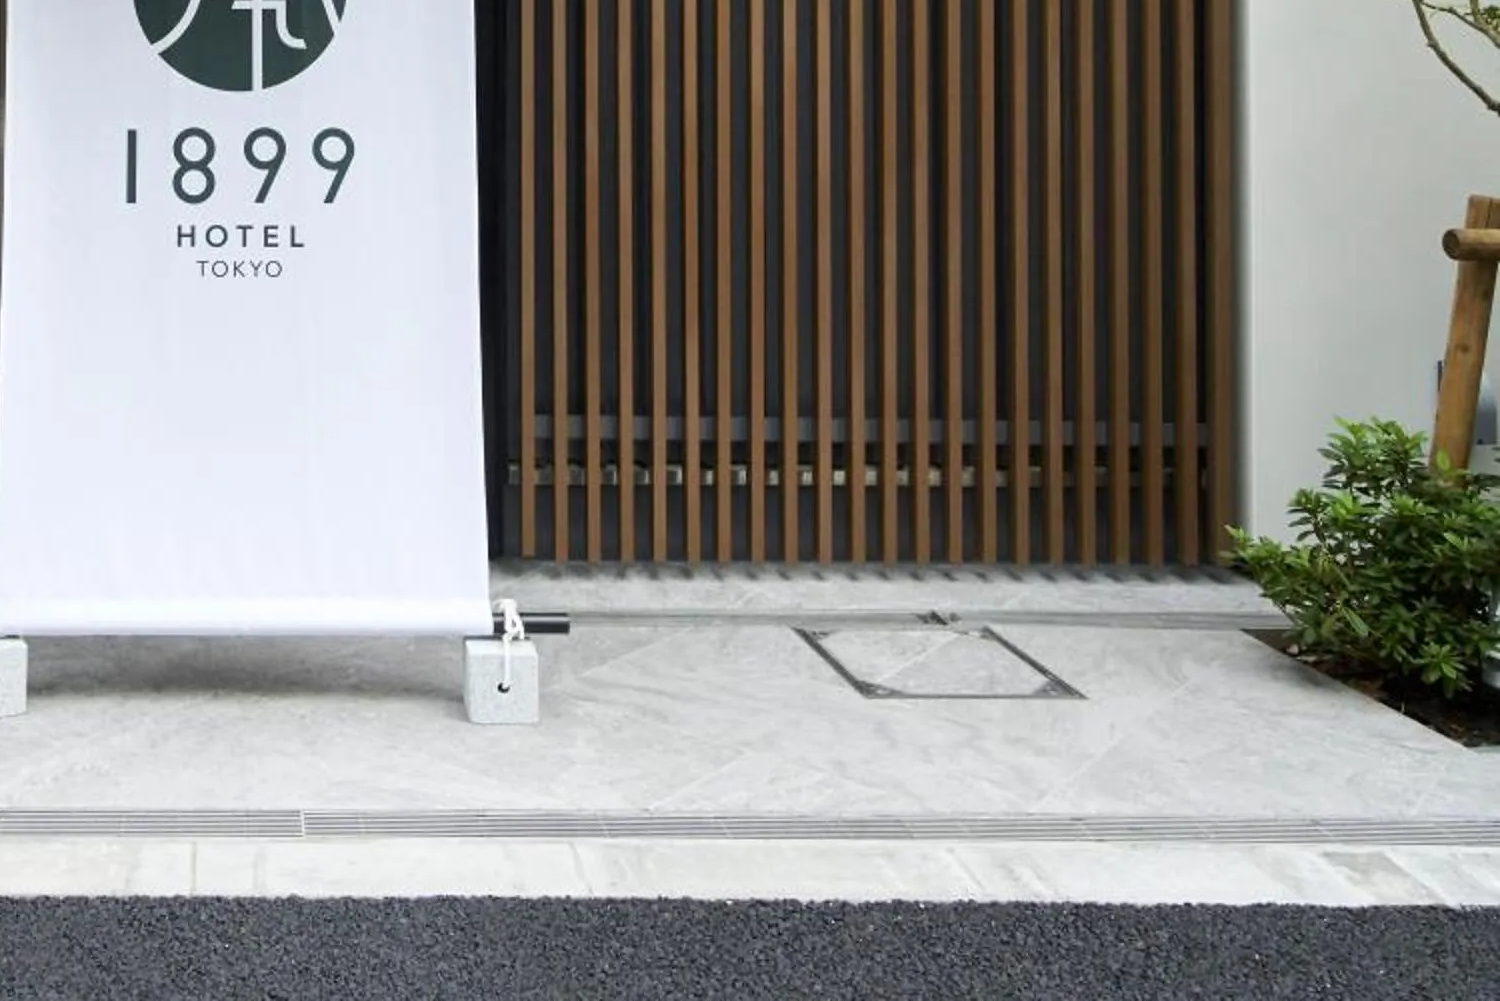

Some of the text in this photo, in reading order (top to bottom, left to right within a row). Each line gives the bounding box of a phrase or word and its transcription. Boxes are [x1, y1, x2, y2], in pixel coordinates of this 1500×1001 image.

[126, 127, 354, 204] 1899
[177, 225, 304, 247] HOTEL
[197, 261, 283, 277] TOKYO
